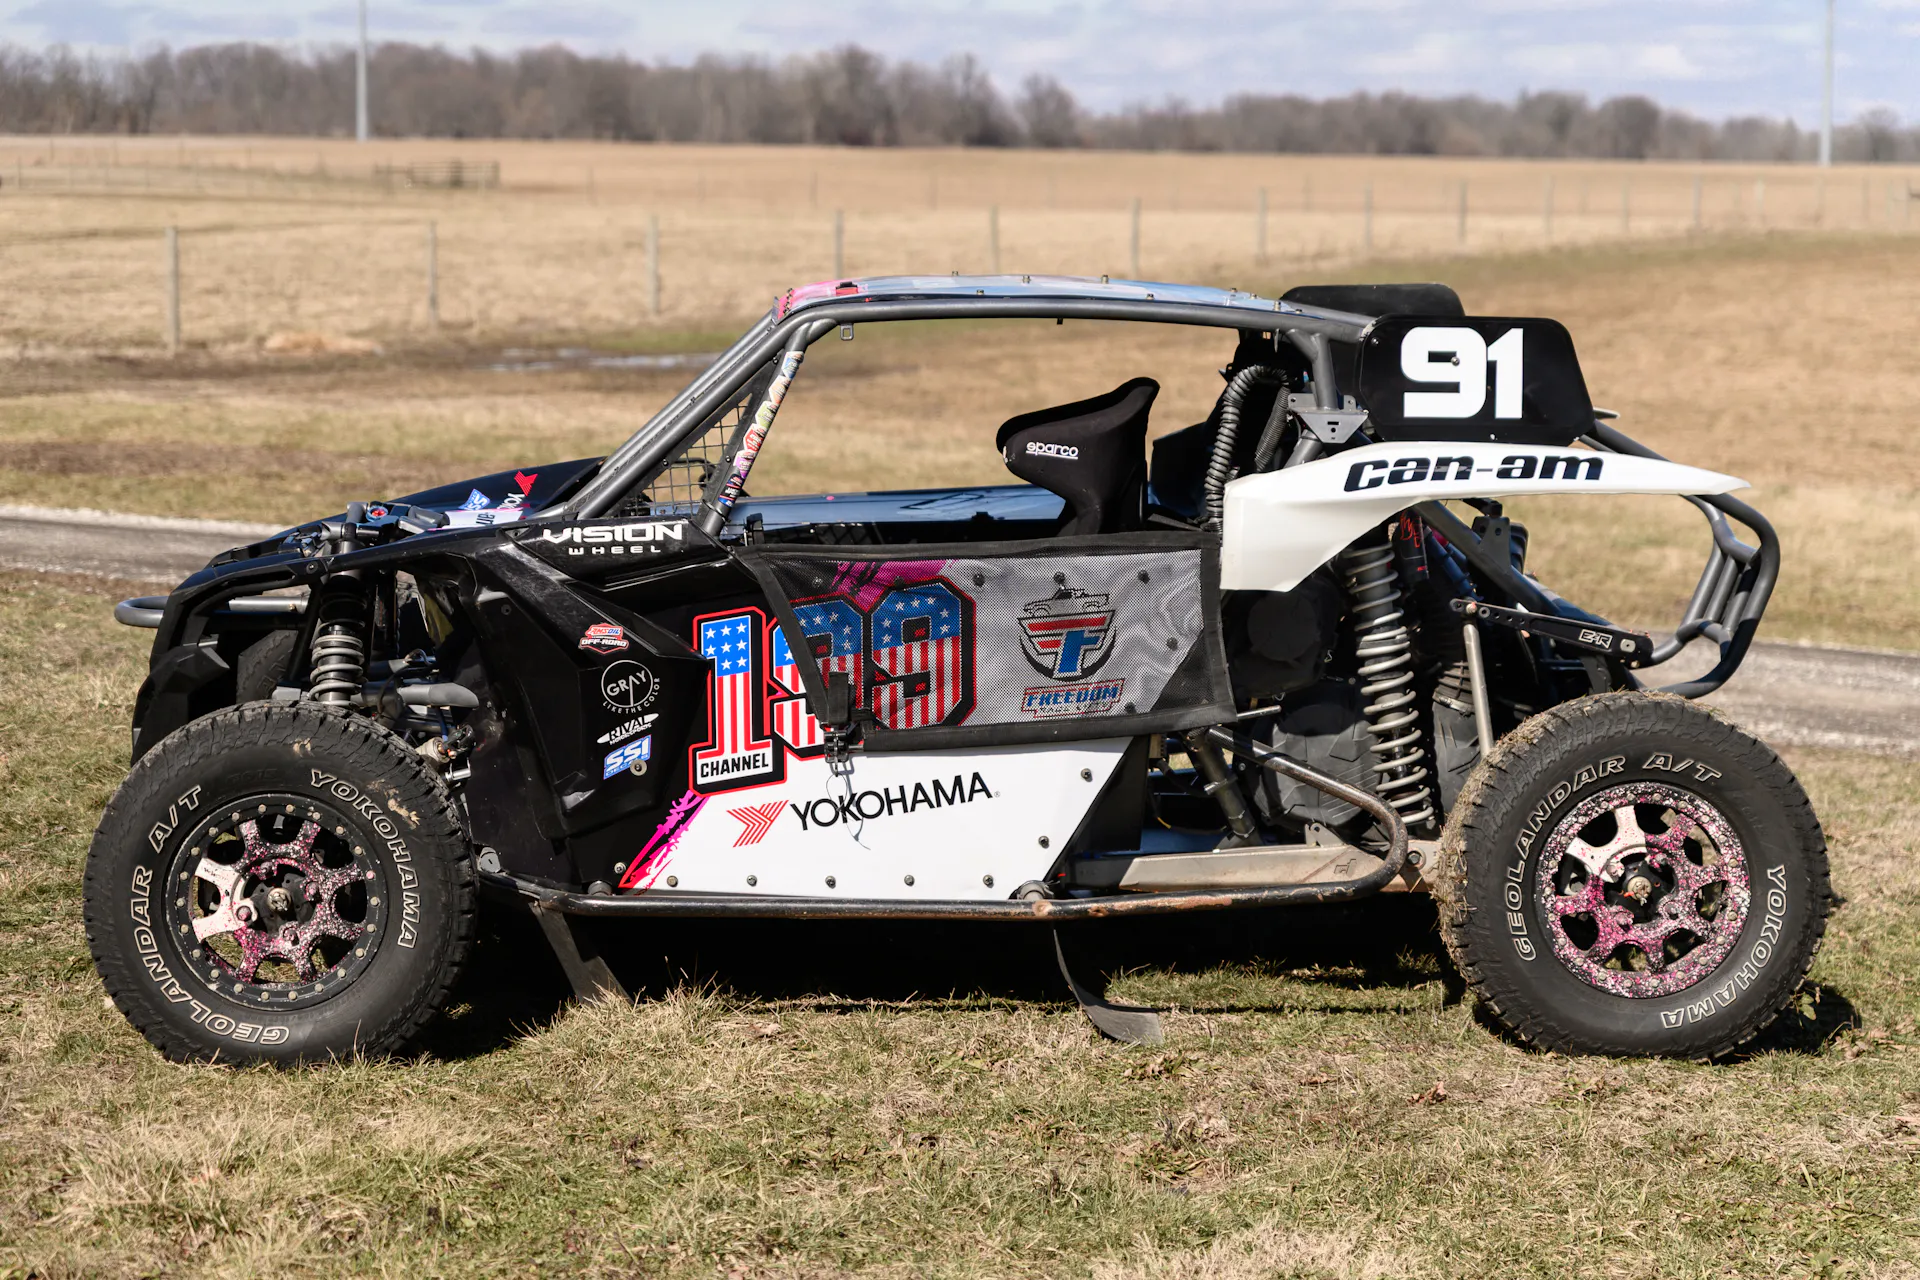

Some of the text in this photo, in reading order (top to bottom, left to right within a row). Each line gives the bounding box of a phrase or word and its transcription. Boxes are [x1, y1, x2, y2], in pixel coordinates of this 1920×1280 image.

[1400, 326, 1524, 419] 91
[1026, 441, 1079, 457] sparco
[1343, 455, 1604, 492] can-am
[543, 524, 683, 544] VISION
[568, 545, 661, 556] WHEEL
[581, 638, 628, 648] OFF-ROAD
[590, 628, 621, 636] AMSOIL
[606, 670, 647, 696] GRAY
[695, 580, 966, 770] 199
[1026, 686, 1119, 707] FREEDOM
[609, 716, 647, 741] RIVAL
[606, 736, 650, 773] SSI
[700, 752, 769, 778] CHANNEL
[148, 784, 202, 853] A/T
[790, 771, 994, 831] YOKOHAMA
[310, 768, 421, 949] YOKOHAMA
[1505, 753, 1722, 961] GEOLANDAR A/T
[130, 865, 291, 1046] GEOLANDAR
[1660, 864, 1788, 1029] YOKOHAMA
